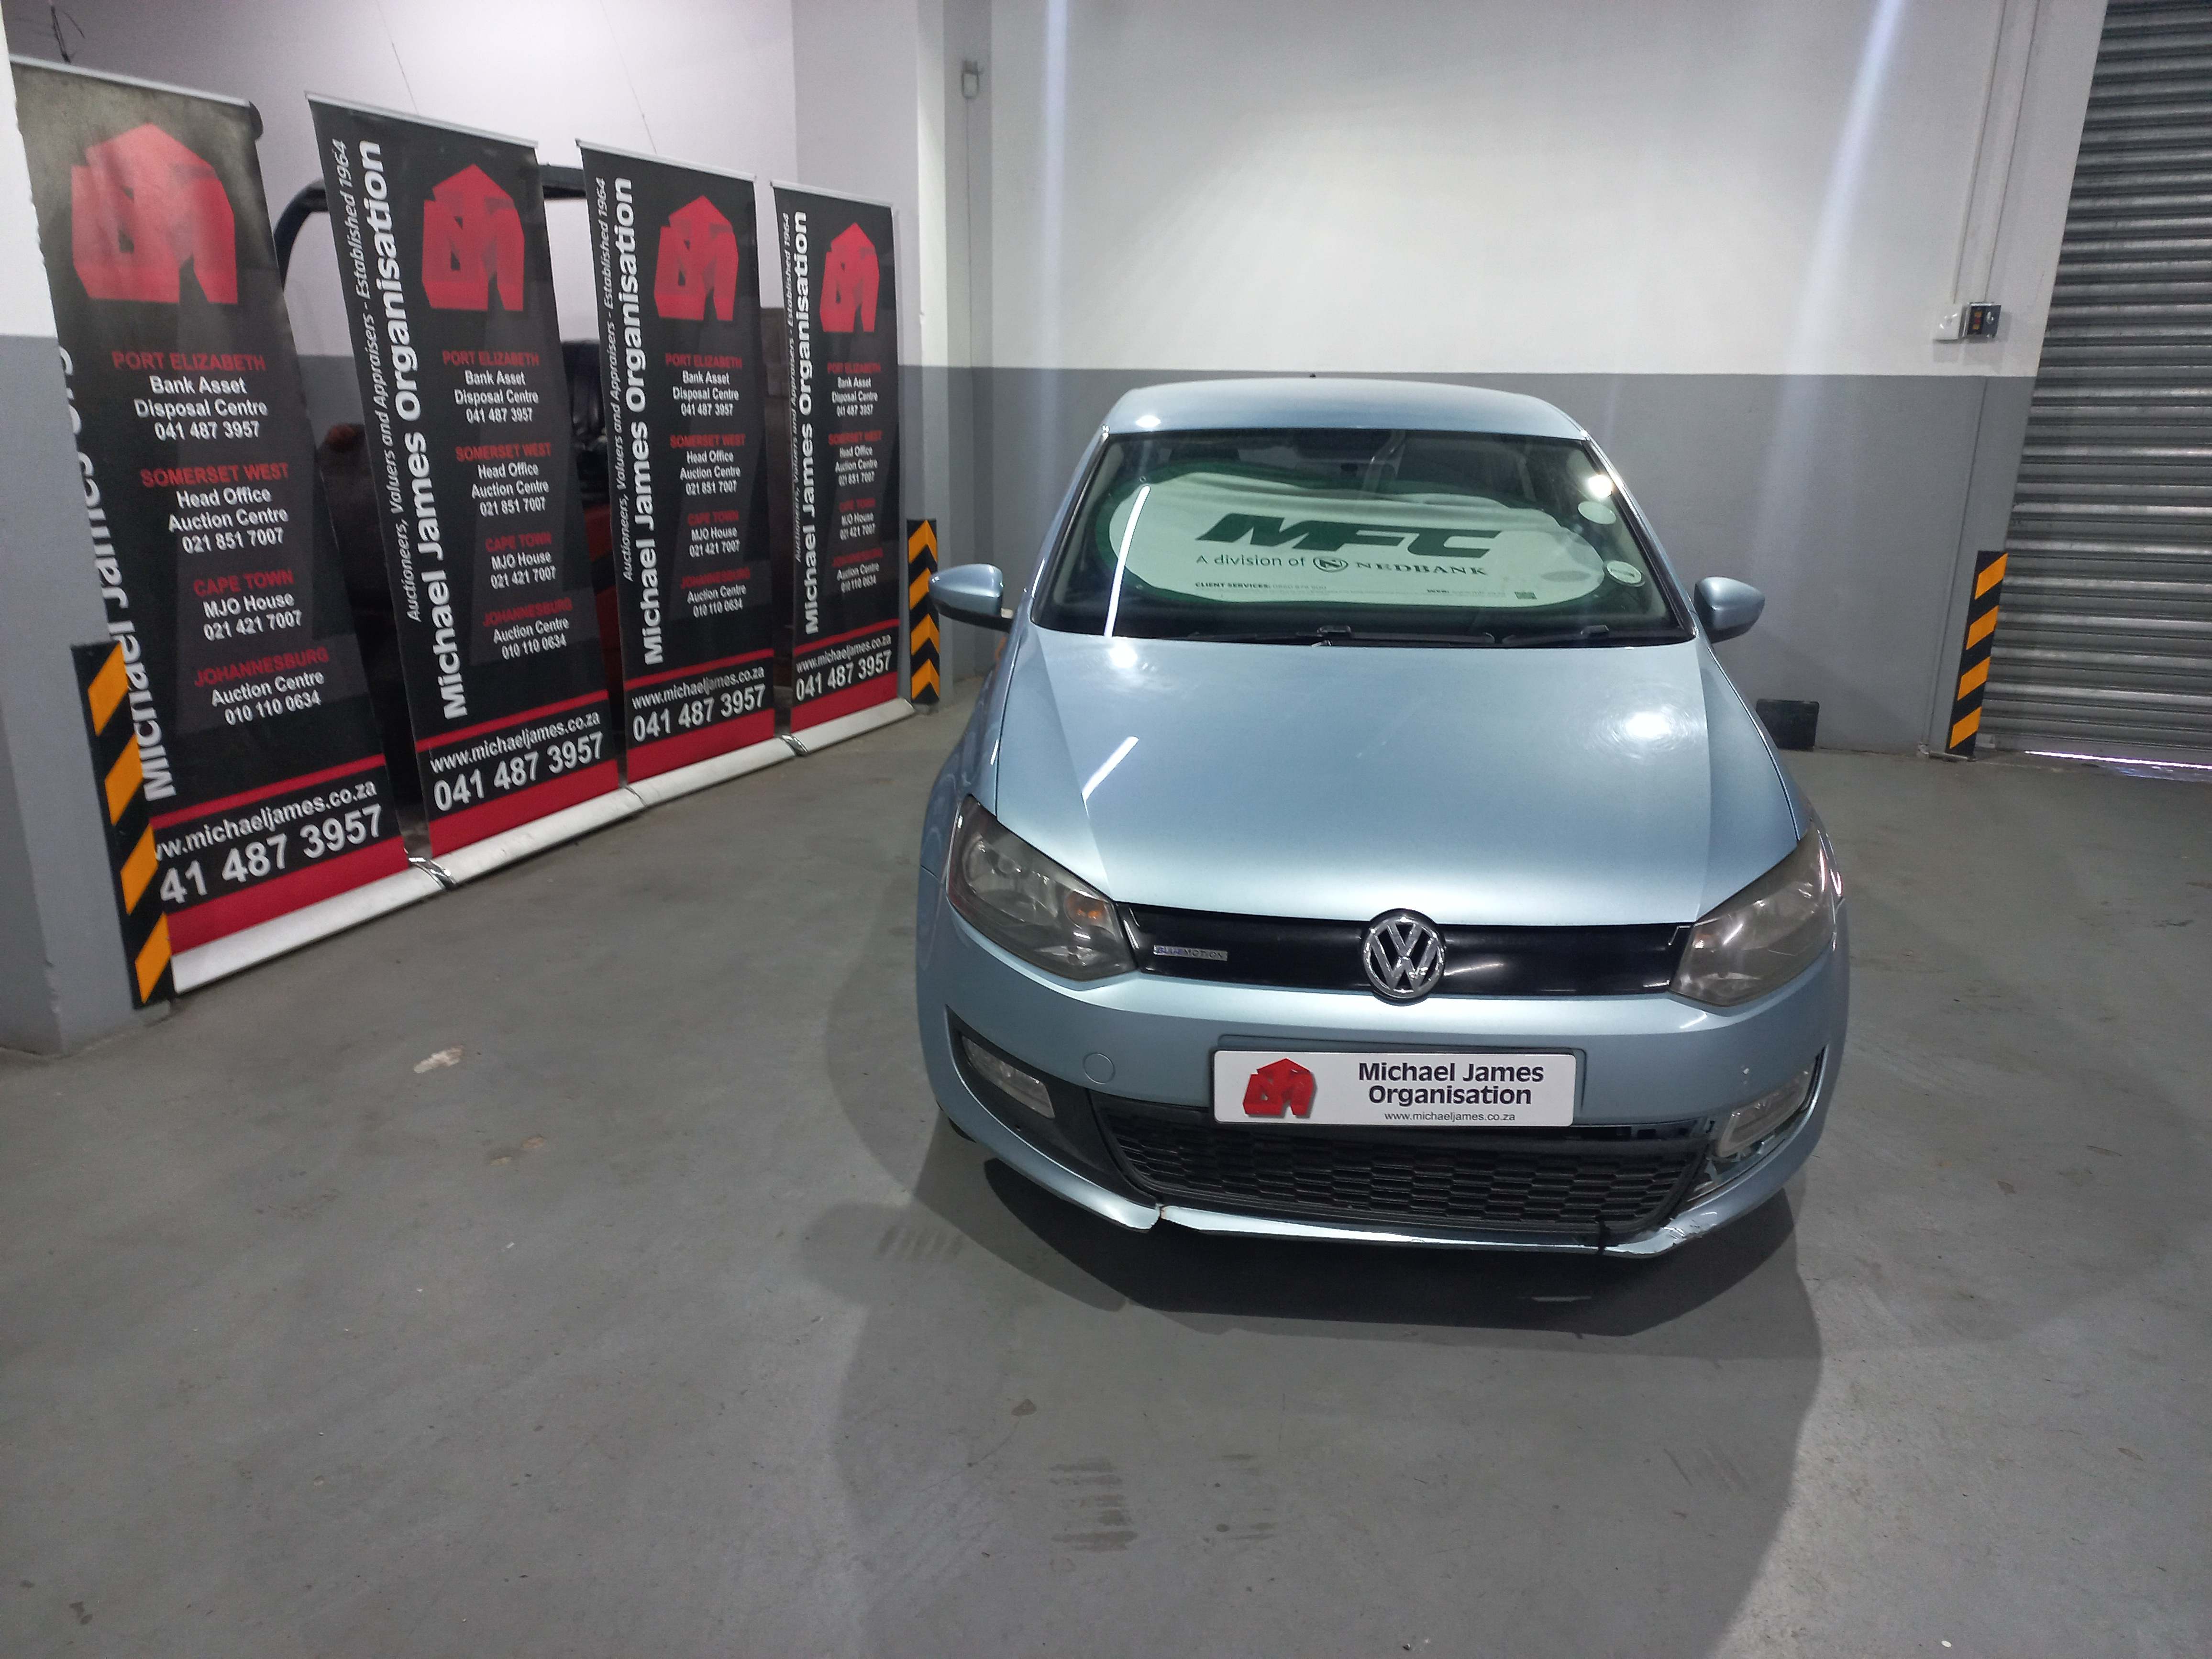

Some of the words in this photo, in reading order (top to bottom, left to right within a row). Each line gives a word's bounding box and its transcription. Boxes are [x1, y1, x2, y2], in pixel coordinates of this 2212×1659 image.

[332, 138, 353, 188] 1964
[596, 177, 608, 217] 1964
[339, 189, 371, 300] Established
[598, 219, 614, 310] Established
[359, 140, 421, 421] Organisation
[614, 177, 646, 412] Organisation
[794, 211, 813, 416] Organisation
[111, 351, 165, 370] PORT
[169, 353, 266, 371] ELIZABETH
[363, 312, 389, 408] Appraisers
[442, 351, 475, 365] PORT
[607, 321, 621, 401] Appraisers
[149, 375, 195, 394] Bank
[199, 376, 248, 395] Asset
[465, 370, 494, 385] Bank
[497, 370, 526, 386] Asset
[682, 370, 704, 384] Bank
[705, 371, 730, 385] Asset
[454, 388, 504, 407] Disposal
[506, 388, 539, 404] Centre
[673, 386, 710, 402] Disposal
[712, 387, 739, 401] Centre
[133, 398, 211, 421] Disposal
[214, 398, 269, 416] Centre
[466, 408, 486, 424] 041
[488, 407, 508, 422] 487
[510, 407, 532, 422] 3957
[610, 402, 622, 433] and
[681, 403, 696, 416] 041
[697, 403, 712, 416] 487
[154, 421, 186, 441] 041
[189, 421, 218, 440] 487
[222, 420, 260, 438] 3957
[374, 410, 394, 447] and
[477, 463, 506, 478] Head
[508, 461, 539, 477] Office
[614, 435, 627, 490] Valuers
[686, 450, 707, 464] Head
[709, 449, 734, 463] Office
[140, 465, 238, 487] SOMERSET
[243, 462, 288, 481] WEST
[385, 449, 404, 514] Valuers
[630, 421, 654, 531] James
[680, 467, 712, 481] Auction
[714, 465, 741, 478] Centre
[802, 423, 815, 518] James
[176, 488, 221, 509] Head
[223, 487, 273, 505] Office
[404, 431, 444, 561] James
[471, 481, 514, 499] Auction
[516, 479, 550, 495] Centre
[686, 482, 700, 496] 021
[702, 481, 716, 494] 851
[718, 480, 737, 493] 7007
[168, 512, 234, 533] Auction
[236, 507, 289, 526] Centre
[479, 499, 499, 517] 021
[502, 498, 520, 515] 851
[522, 496, 546, 512] 7007
[182, 534, 212, 554] 021
[215, 531, 244, 551] 851
[246, 527, 284, 547] 7007
[485, 535, 516, 553] CAPE
[710, 527, 738, 540] House
[1195, 513, 1502, 558] MFC
[491, 553, 516, 571] MJO
[517, 551, 552, 567] House
[689, 544, 703, 558] 021
[705, 542, 719, 555] 421
[721, 539, 740, 553] 7007
[490, 573, 509, 589] 021
[512, 569, 531, 586] 421
[532, 565, 556, 582] 7007
[1196, 554, 1208, 564] A
[1214, 554, 1282, 566] division
[1288, 556, 1305, 567] of
[1357, 561, 1488, 575] NEDBANK
[194, 575, 241, 597] CAPE
[243, 569, 295, 589] TOWN
[803, 525, 818, 635] Michael
[203, 597, 241, 619] MJO
[243, 593, 295, 612] House
[635, 539, 664, 665] Michael
[687, 588, 719, 604] Auction
[720, 584, 747, 598] Centre
[693, 604, 708, 618] 010
[709, 601, 723, 615] 110
[203, 621, 232, 641] 021
[236, 616, 264, 635] 421
[266, 609, 302, 630] 7007
[493, 624, 534, 644] Auction
[535, 617, 569, 634] Centre
[421, 570, 468, 720] Michael
[502, 642, 520, 660] 010
[522, 638, 541, 655] 110
[542, 633, 567, 651] 0634
[194, 647, 329, 687] JOHANNESBURG
[796, 672, 822, 701] 041
[828, 662, 854, 689] 487
[858, 649, 892, 680] 3957
[211, 682, 273, 707] Auction
[275, 671, 325, 692] Centre
[224, 705, 253, 726] 010
[255, 698, 283, 718] 110
[285, 689, 321, 712] 0634
[633, 708, 671, 741] 041
[678, 697, 715, 728] 487
[720, 683, 765, 718] 3957
[430, 711, 601, 774] www.michaeljames.co.za
[434, 768, 484, 811] 041
[494, 751, 539, 790] 487
[547, 731, 603, 774] 3957
[156, 781, 378, 861] w.michaeljames.co.za
[160, 861, 207, 904] 41
[222, 833, 288, 883] 487
[300, 803, 382, 859] 3957
[1359, 1062, 1455, 1081] Michael
[1462, 1063, 1544, 1083] James
[1369, 1085, 1531, 1107] Organisation
[1384, 1111, 1515, 1123] www.michaeljames.co.za
